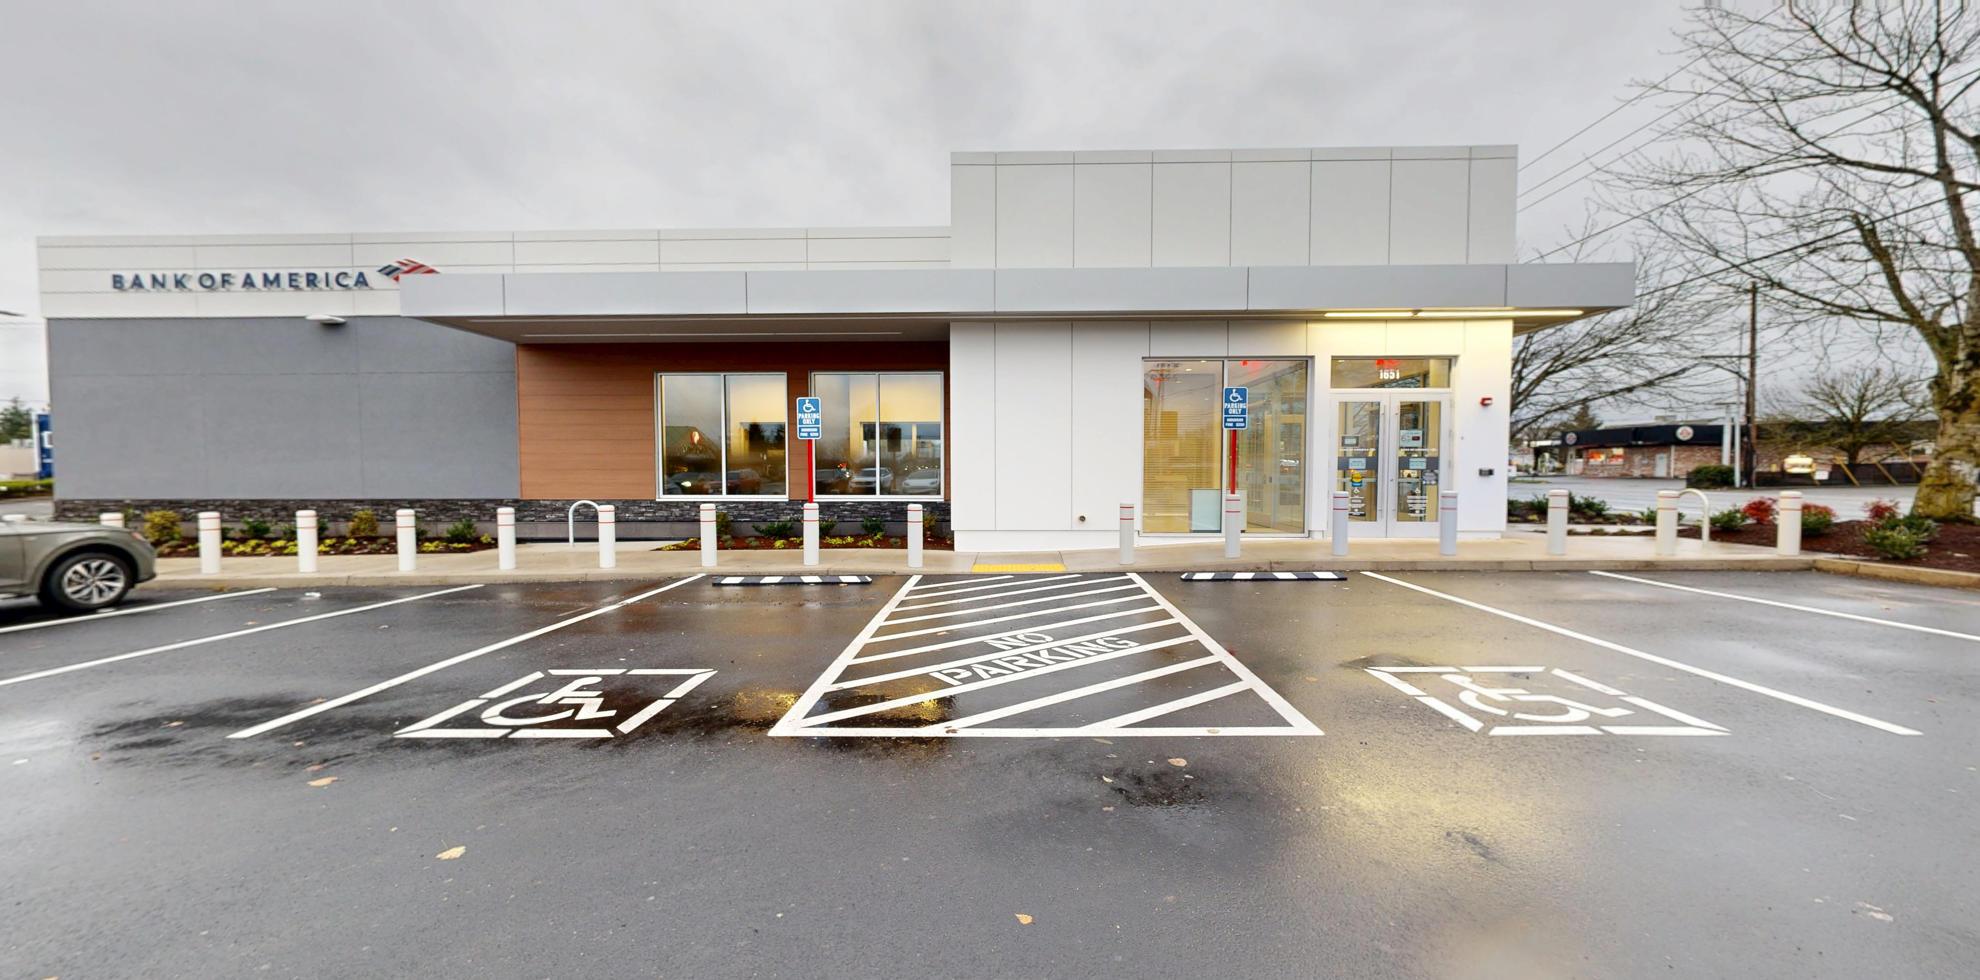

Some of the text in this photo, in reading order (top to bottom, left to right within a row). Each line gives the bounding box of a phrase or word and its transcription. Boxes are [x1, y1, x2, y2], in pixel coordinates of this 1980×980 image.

[112, 271, 370, 290] BANK OF AMERICA
[1379, 369, 1400, 380] 1651
[985, 632, 1054, 651] NO
[929, 637, 1140, 686] PARKING
